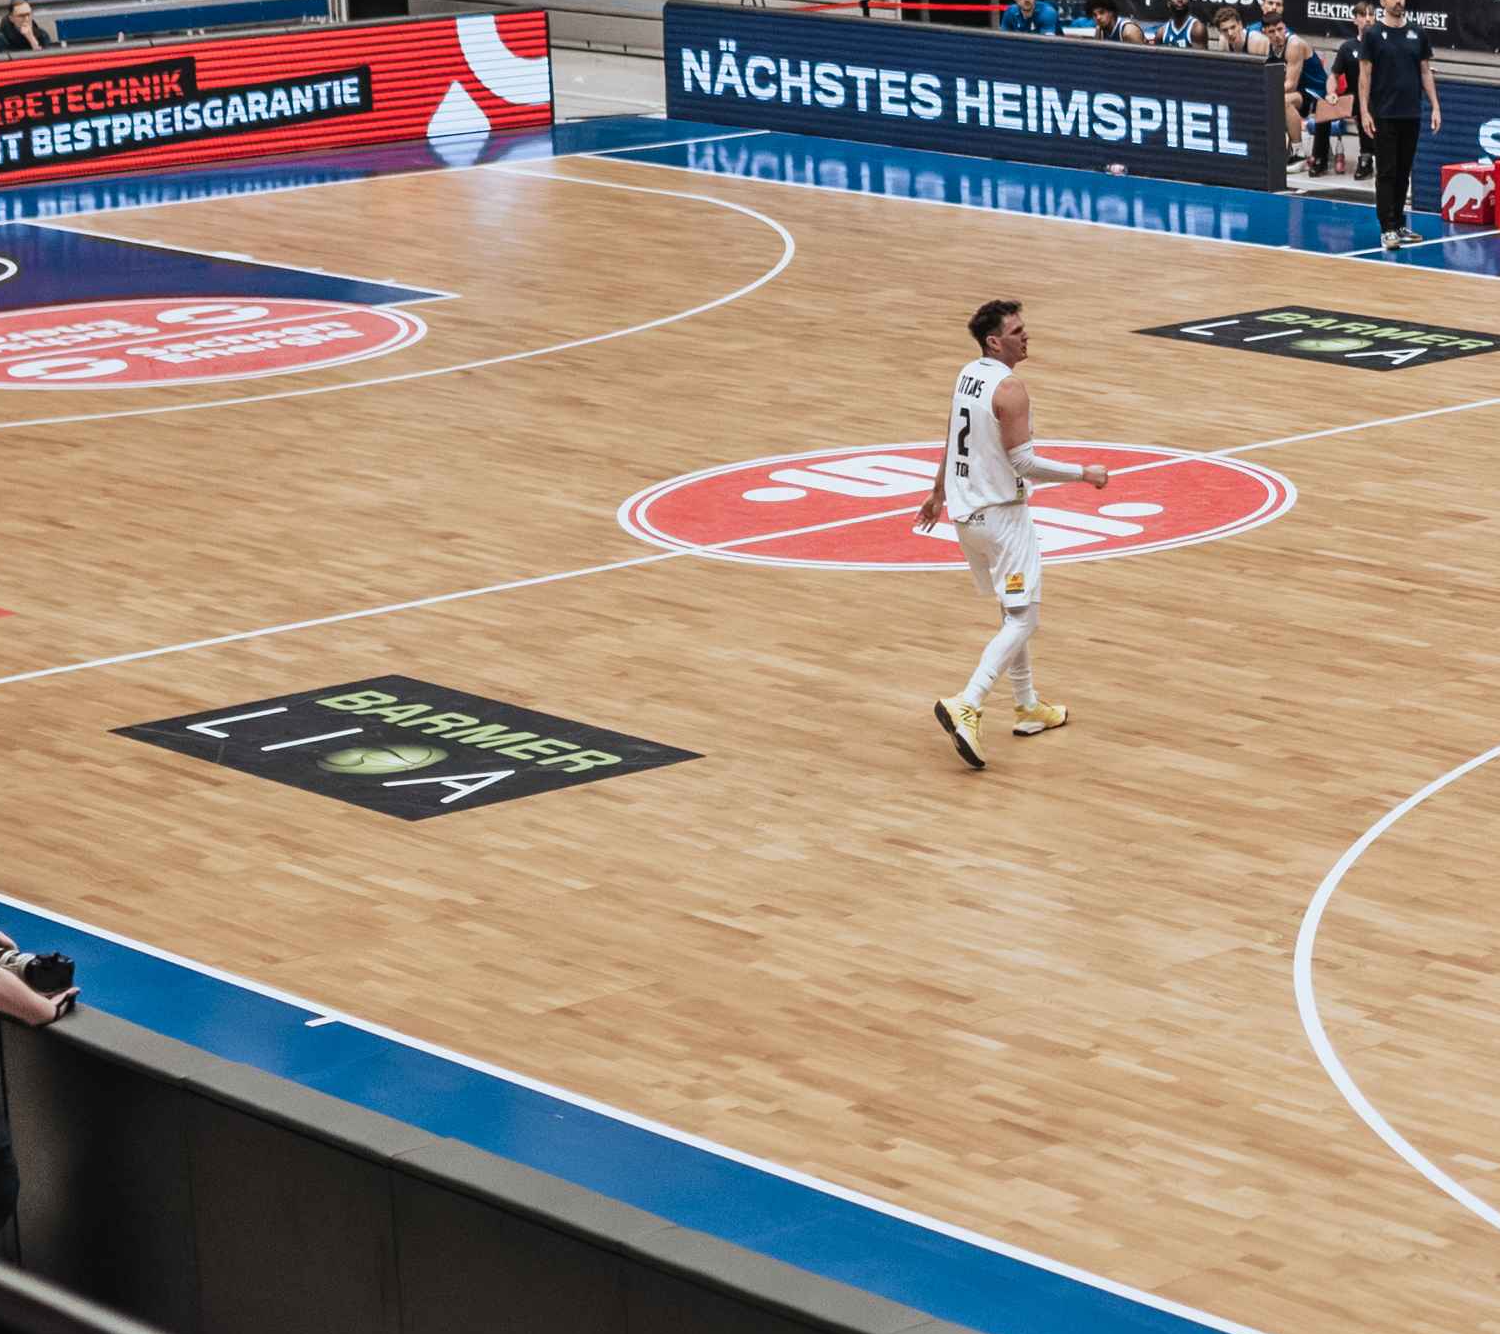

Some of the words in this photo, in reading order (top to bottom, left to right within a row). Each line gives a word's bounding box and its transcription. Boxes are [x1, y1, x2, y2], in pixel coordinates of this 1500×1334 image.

[31, 76, 362, 158] BESTPREISGARANTIE
[681, 39, 943, 121] NÄCHSTES
[955, 75, 1249, 157] HEIMSPIEL
[124, 319, 355, 358] Sachsen
[155, 329, 366, 364] Energie
[1259, 310, 1496, 353] BARMER
[957, 407, 970, 457] 2
[314, 687, 623, 775] BARMER
